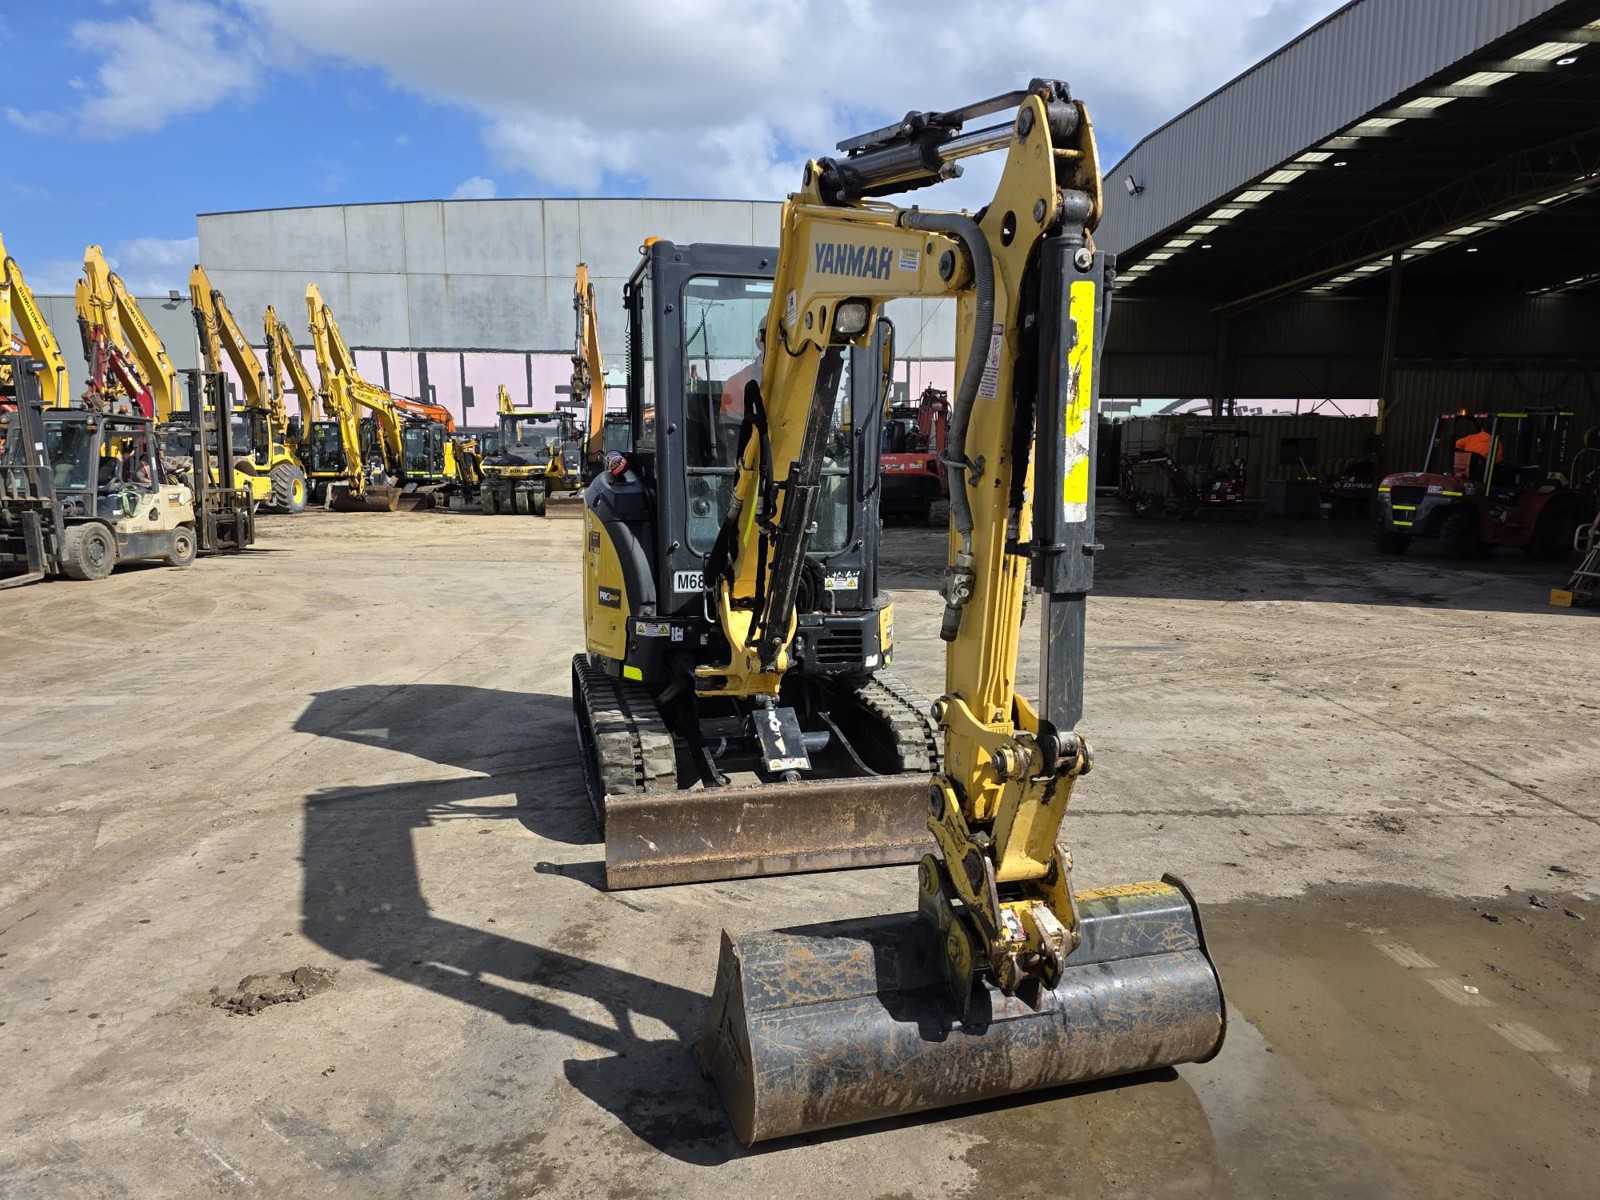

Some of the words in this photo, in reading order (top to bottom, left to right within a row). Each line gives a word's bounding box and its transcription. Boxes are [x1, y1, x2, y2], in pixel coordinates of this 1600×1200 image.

[815, 242, 894, 281] YANMAR
[18, 286, 42, 331] SUMITOMO
[123, 298, 149, 339] SUMITOMO
